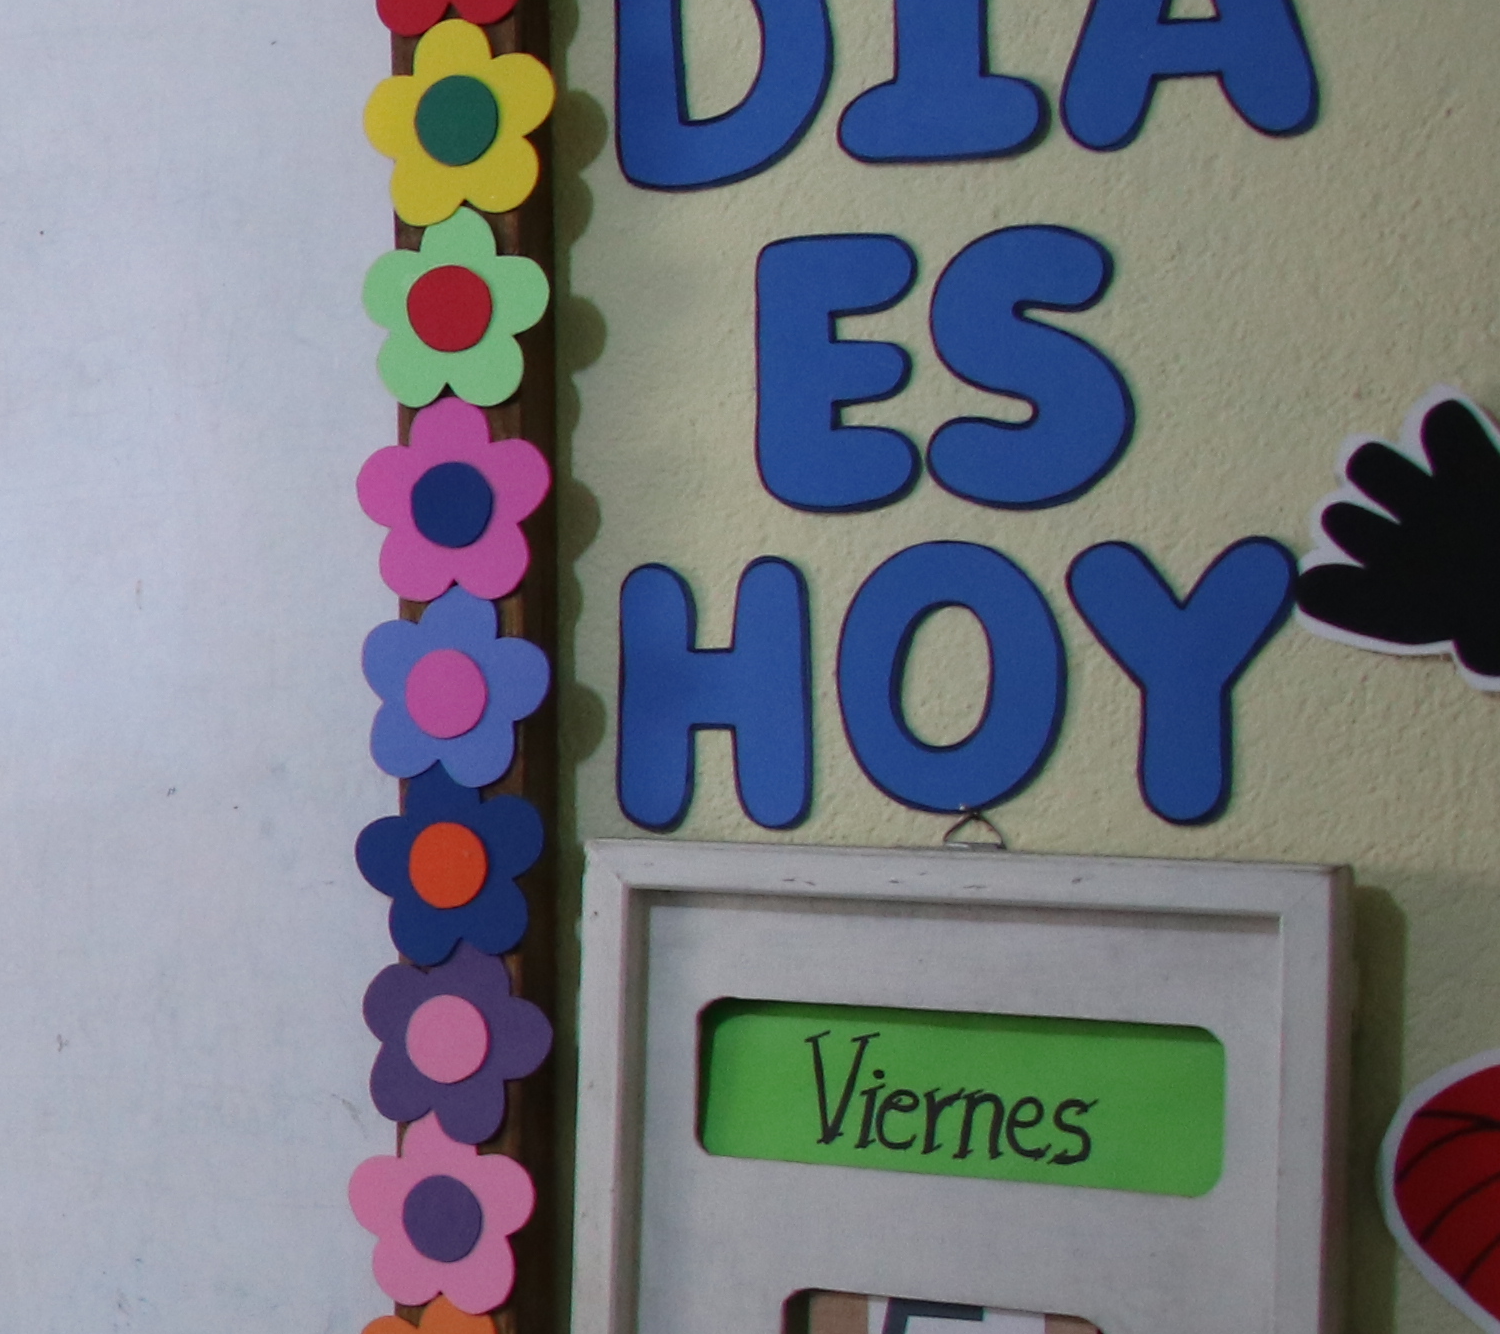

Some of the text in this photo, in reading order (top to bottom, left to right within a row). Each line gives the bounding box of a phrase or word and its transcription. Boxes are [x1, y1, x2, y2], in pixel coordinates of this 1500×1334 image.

[755, 223, 1135, 515] ES
[615, 535, 1299, 831] HOY
[806, 1028, 1098, 1166] Viernes
